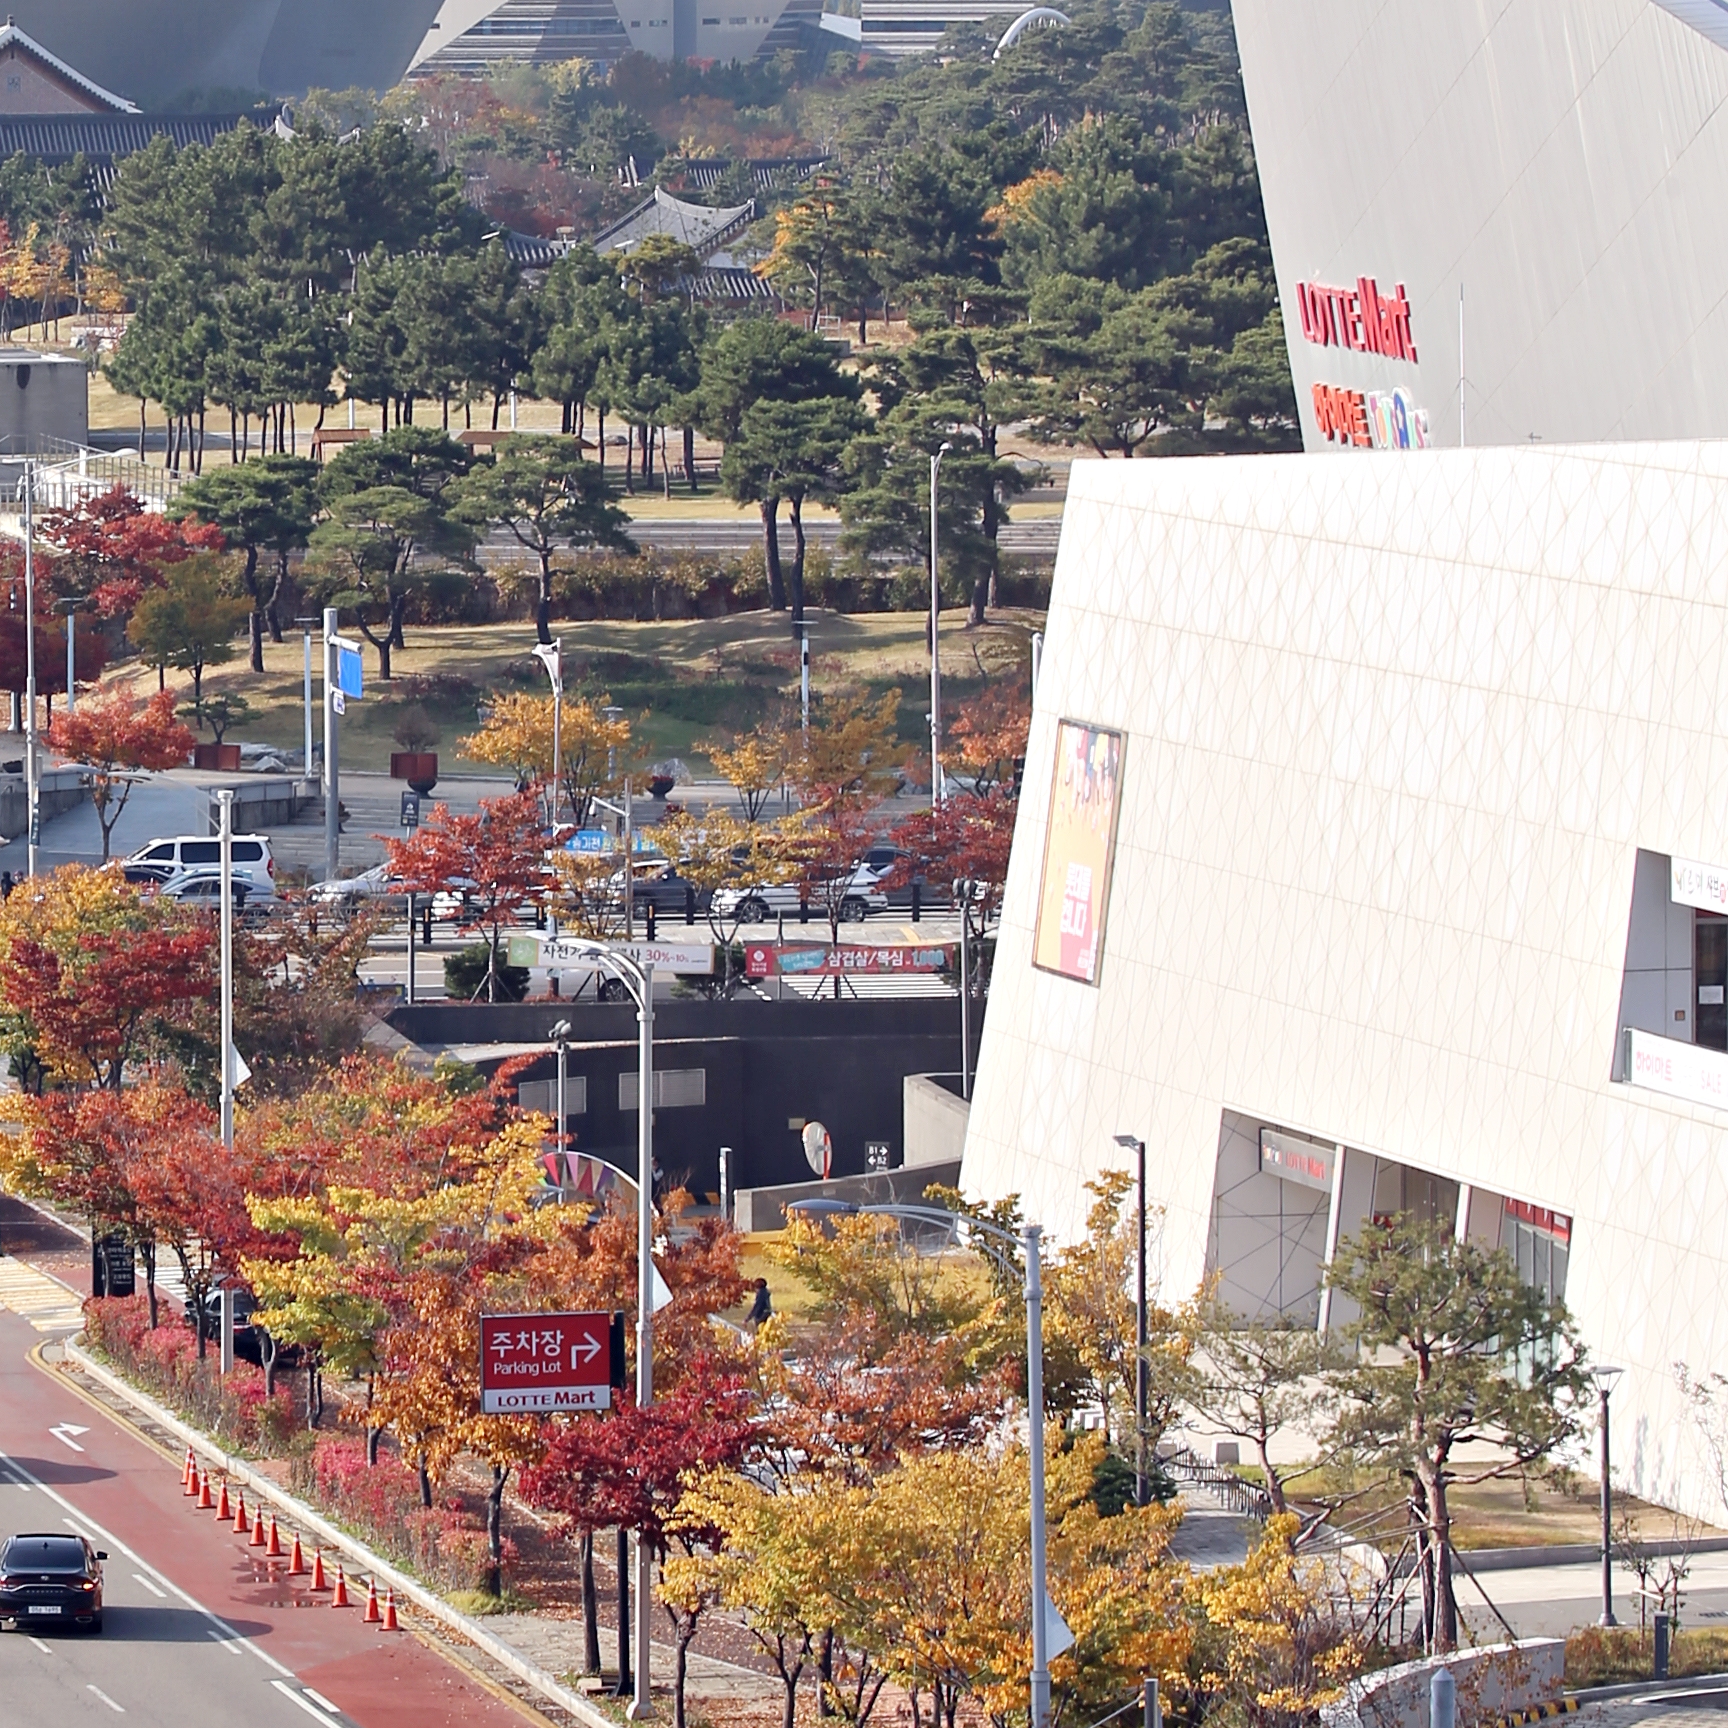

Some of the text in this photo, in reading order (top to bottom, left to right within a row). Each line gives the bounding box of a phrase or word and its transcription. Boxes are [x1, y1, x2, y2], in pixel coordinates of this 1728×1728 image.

[1295, 274, 1419, 365] LOTTE Mart
[490, 1329, 565, 1359] 주차장
[493, 1360, 562, 1377] Parking Lot
[497, 1390, 596, 1407] LOTTE Mart
